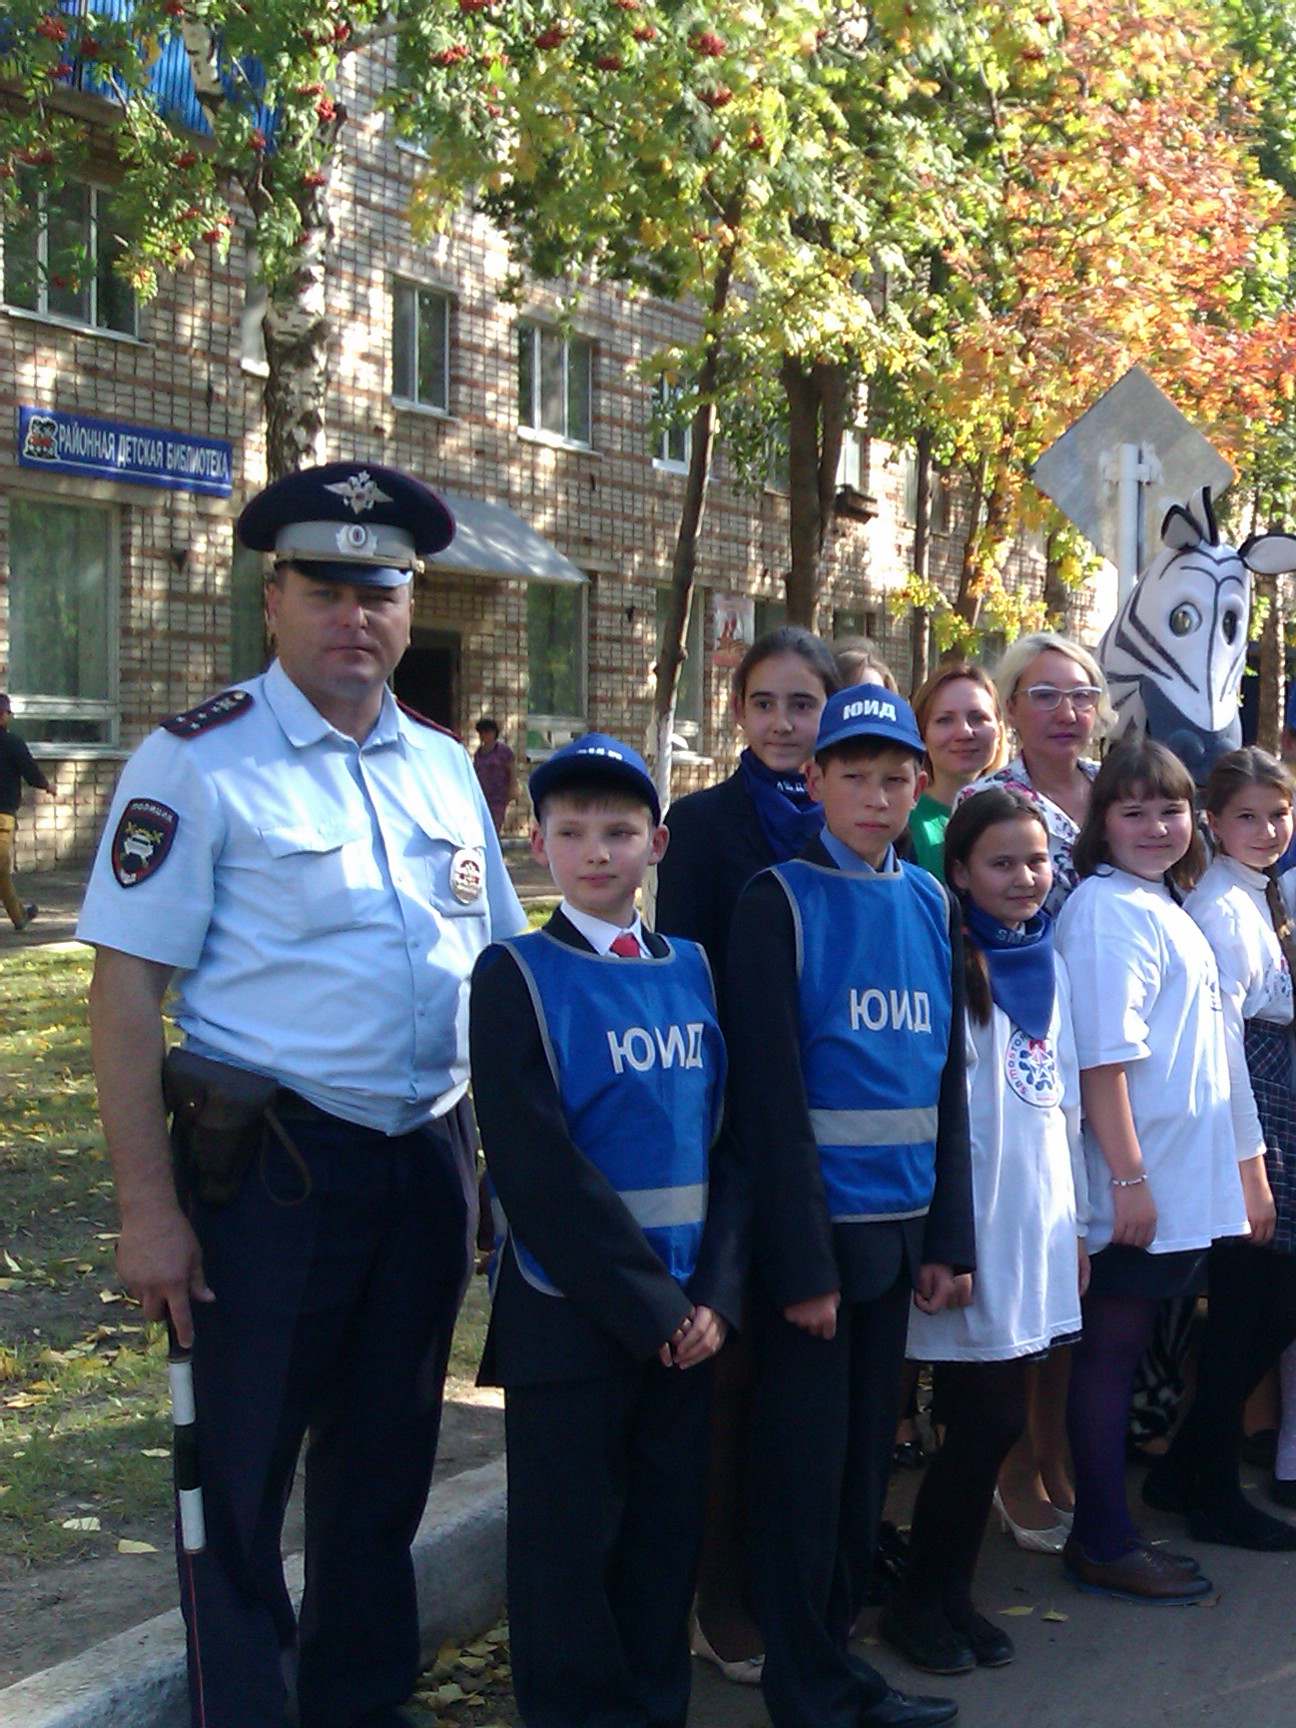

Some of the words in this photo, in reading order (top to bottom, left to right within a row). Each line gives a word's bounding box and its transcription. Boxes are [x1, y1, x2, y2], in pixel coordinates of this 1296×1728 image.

[58, 422, 115, 461] РАЙОННАЯ
[117, 434, 164, 468] ДЕТСКАЯ
[166, 442, 229, 479] БИБЛИОТЕКА
[843, 699, 897, 722] ЮИД
[849, 988, 932, 1034] ЮИД
[607, 1022, 705, 1075] ЮИД
